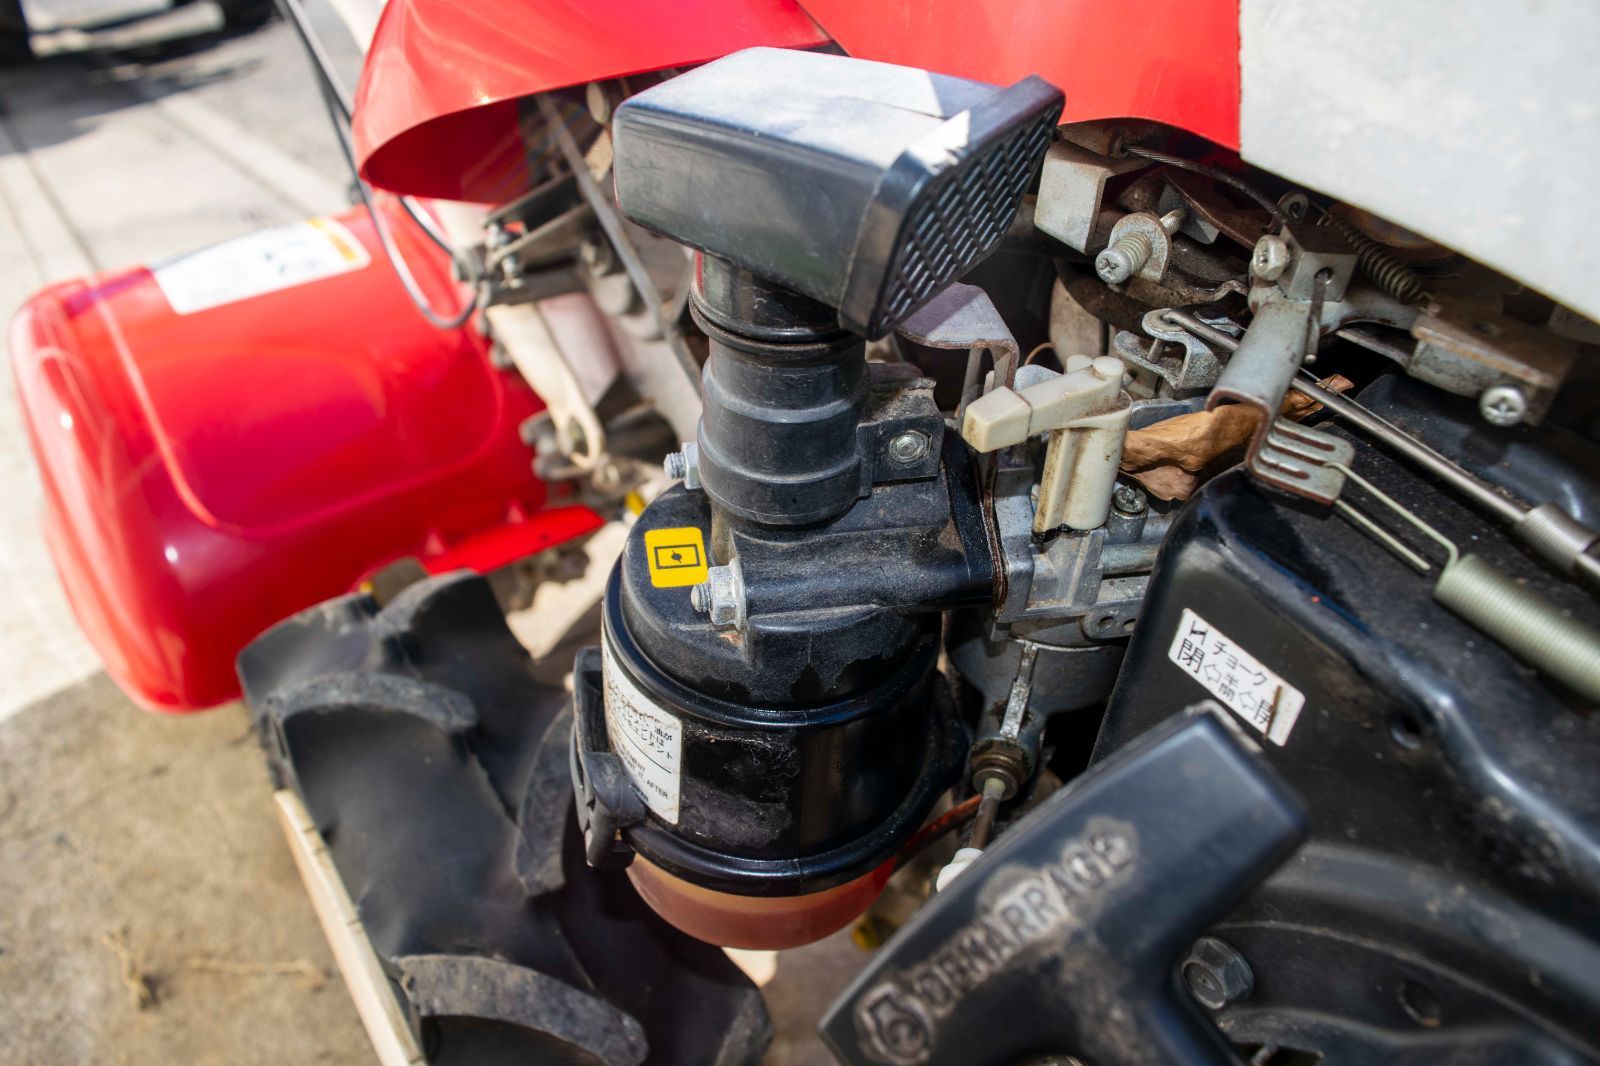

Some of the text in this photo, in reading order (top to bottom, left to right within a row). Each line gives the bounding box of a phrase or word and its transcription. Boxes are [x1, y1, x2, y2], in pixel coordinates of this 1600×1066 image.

[1177, 638, 1205, 673] 閉
[1213, 640, 1268, 687] チョーク
